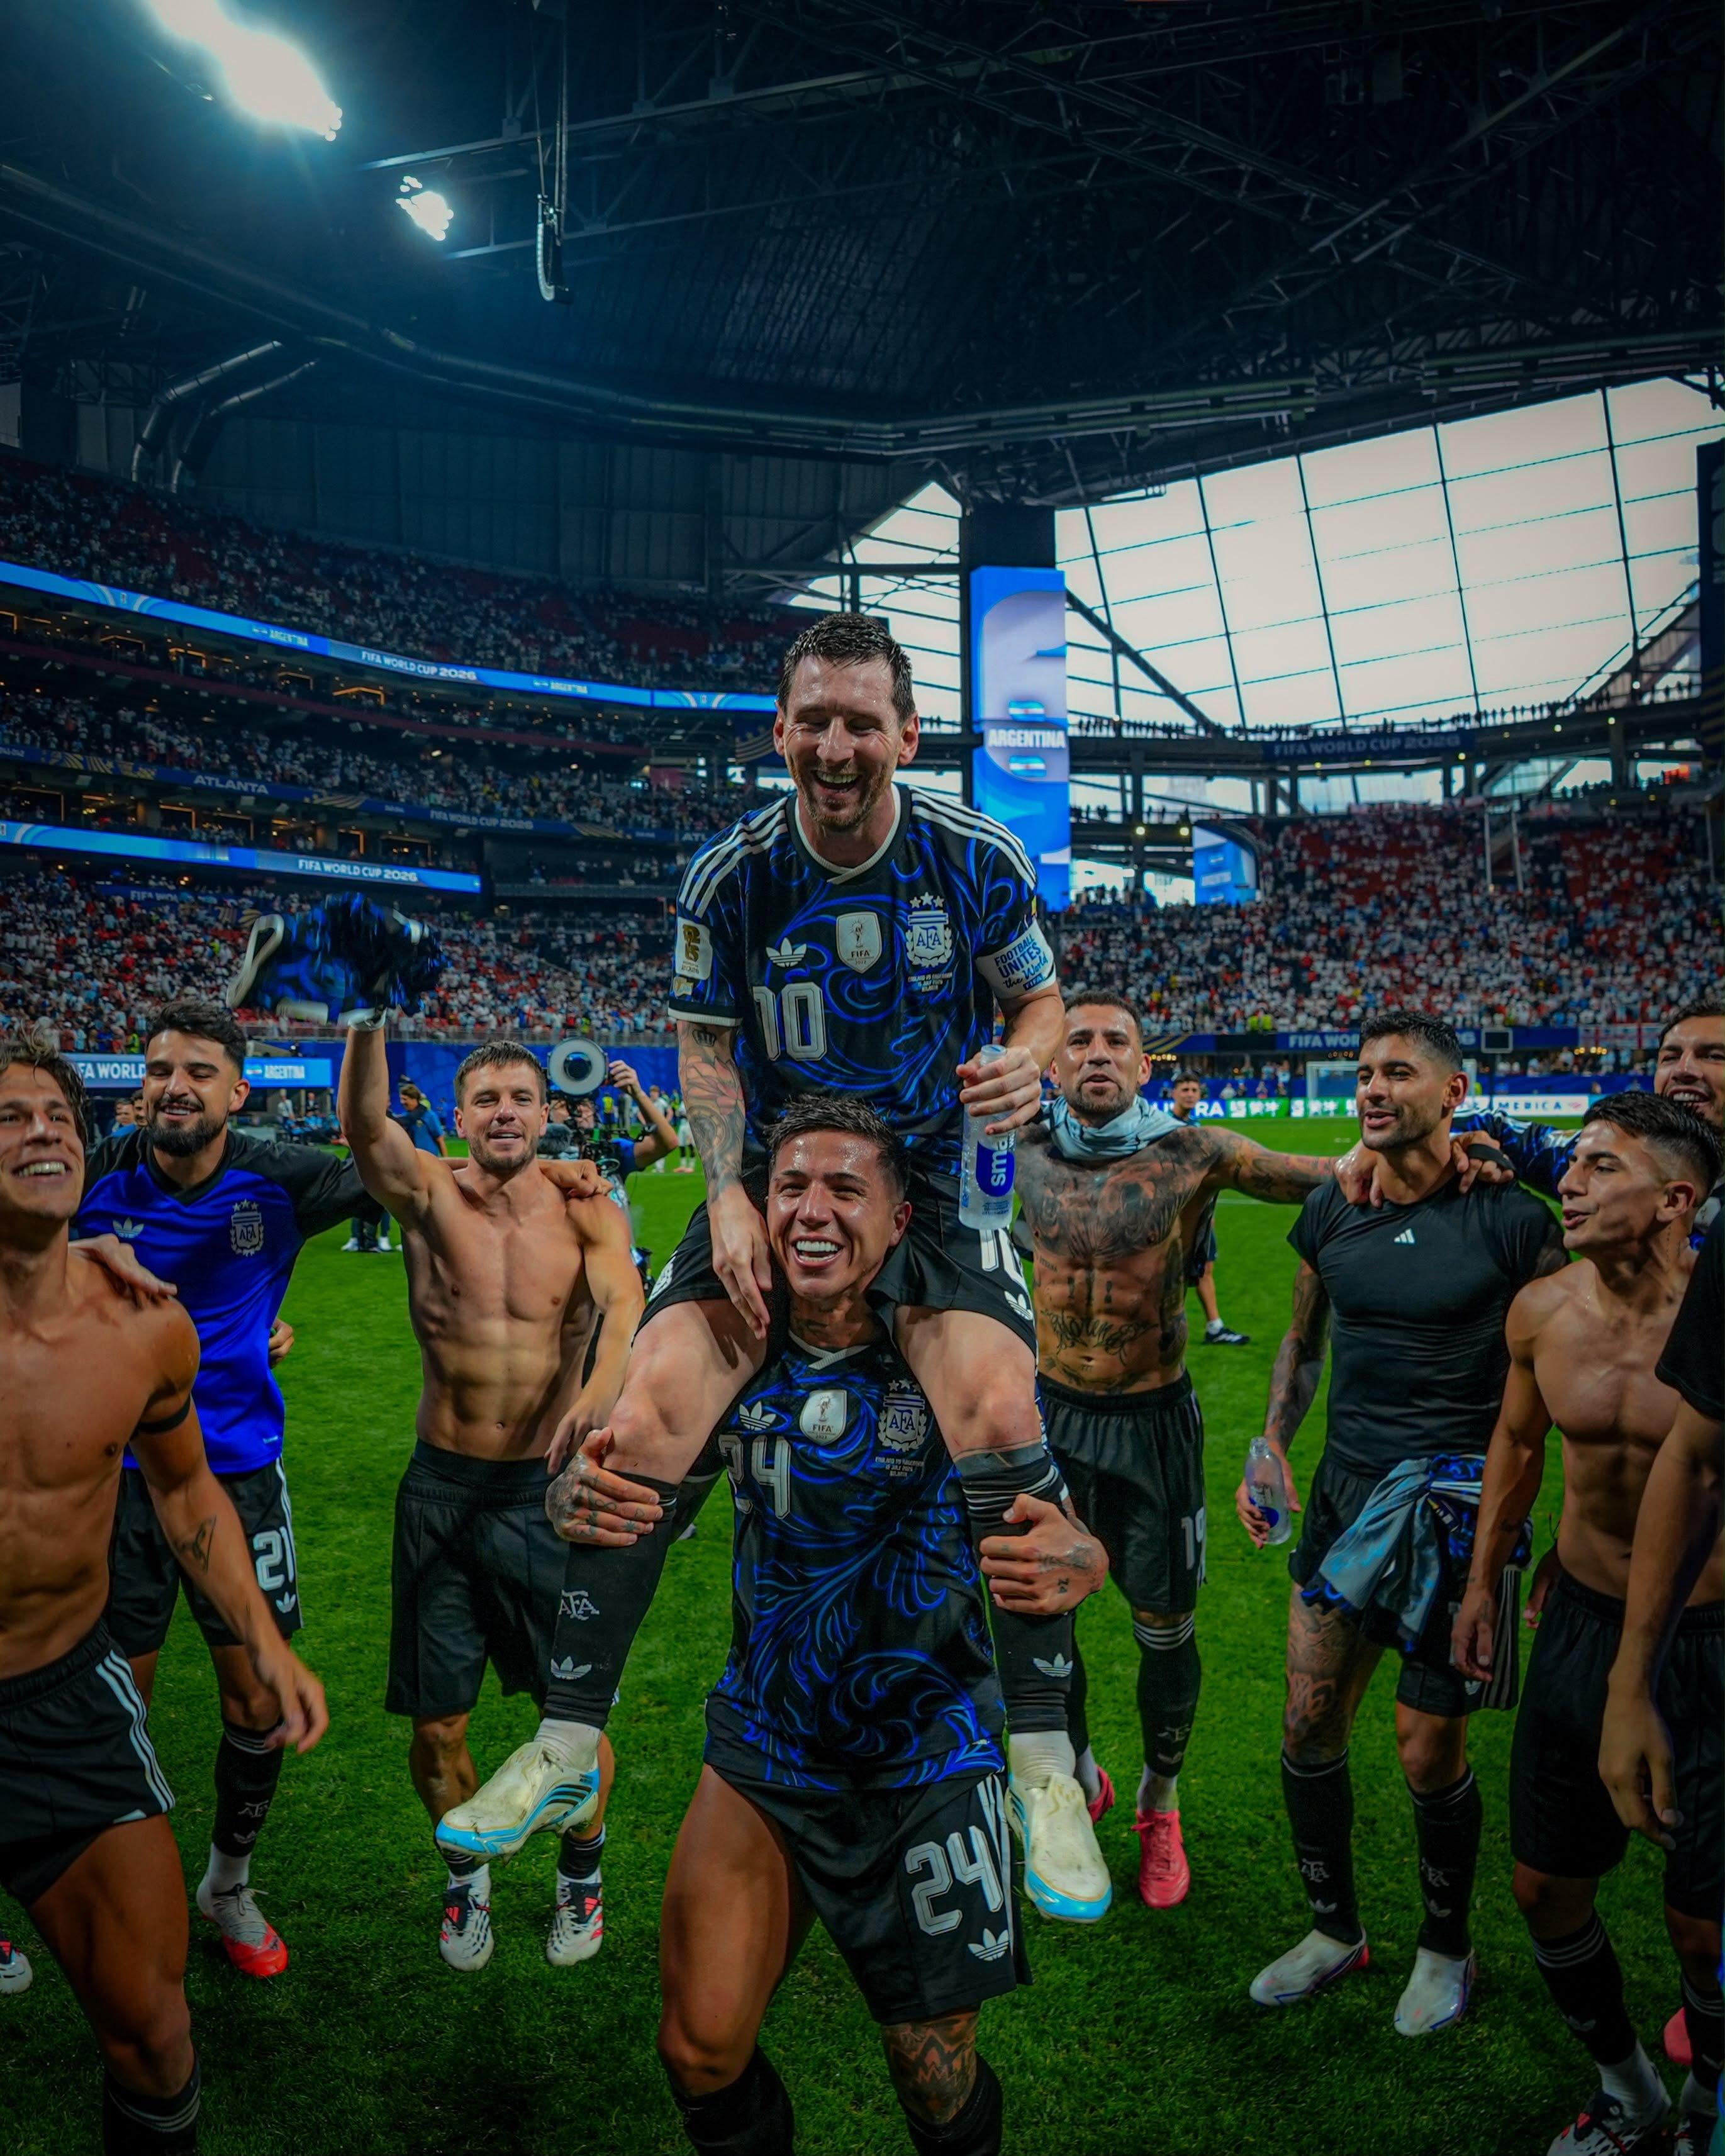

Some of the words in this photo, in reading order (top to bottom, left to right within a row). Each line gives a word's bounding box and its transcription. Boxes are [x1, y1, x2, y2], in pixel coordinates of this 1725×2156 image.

[362, 651, 382, 664] FIFA
[384, 656, 416, 672] WORLD
[417, 663, 437, 676] CUP
[439, 667, 477, 681] 2026
[988, 729, 1066, 749] ARGENTINA
[1274, 742, 1307, 756] FIFA
[1309, 739, 1366, 755] WORLD
[1370, 737, 1402, 752] CUP
[1404, 734, 1460, 750] 2026
[194, 774, 269, 795] ATLANTA
[449, 813, 478, 825] WORLD
[479, 817, 499, 827] CUP
[500, 818, 533, 830] 2026
[298, 859, 321, 872] FIFA
[322, 861, 360, 876] WORLD
[361, 866, 382, 878] CUP
[382, 869, 418, 882] 2026
[130, 890, 154, 902] FIFA
[995, 934, 1034, 966] FOOTBALL
[998, 942, 1041, 978] UNITES
[1003, 978, 1023, 988] the
[1022, 951, 1048, 980] World
[752, 981, 827, 1061] 10
[1288, 1034, 1322, 1049] FIFA
[264, 1065, 305, 1079] ARGENTINA
[1499, 1101, 1561, 1110] MERICA
[991, 1137, 1008, 1187] sma
[253, 1526, 294, 1591] 21
[905, 1825, 1003, 1936] 24
